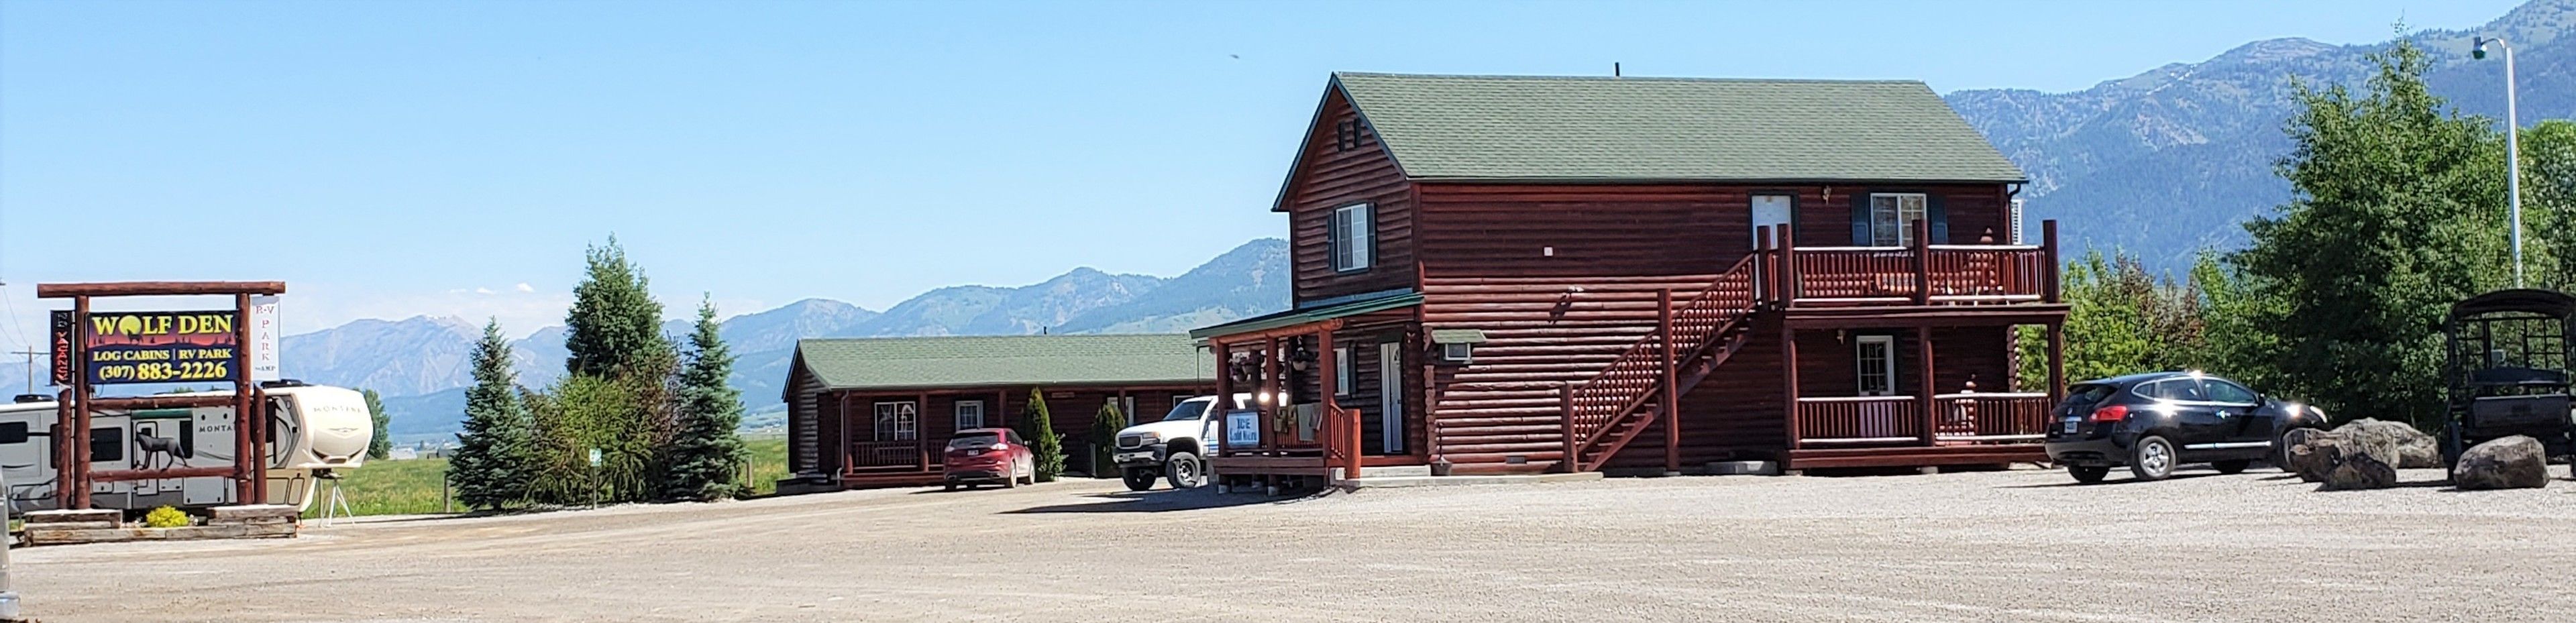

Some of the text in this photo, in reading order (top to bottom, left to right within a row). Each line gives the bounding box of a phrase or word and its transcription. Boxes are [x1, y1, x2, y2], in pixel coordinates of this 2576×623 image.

[91, 314, 234, 336] WOLF DEN
[261, 319, 270, 361] PARK
[93, 347, 233, 362] LOG CABINS RV PARK
[99, 361, 228, 381] (307) 883-2226
[199, 424, 232, 433] MONTA
[1236, 418, 1251, 430] ICE
